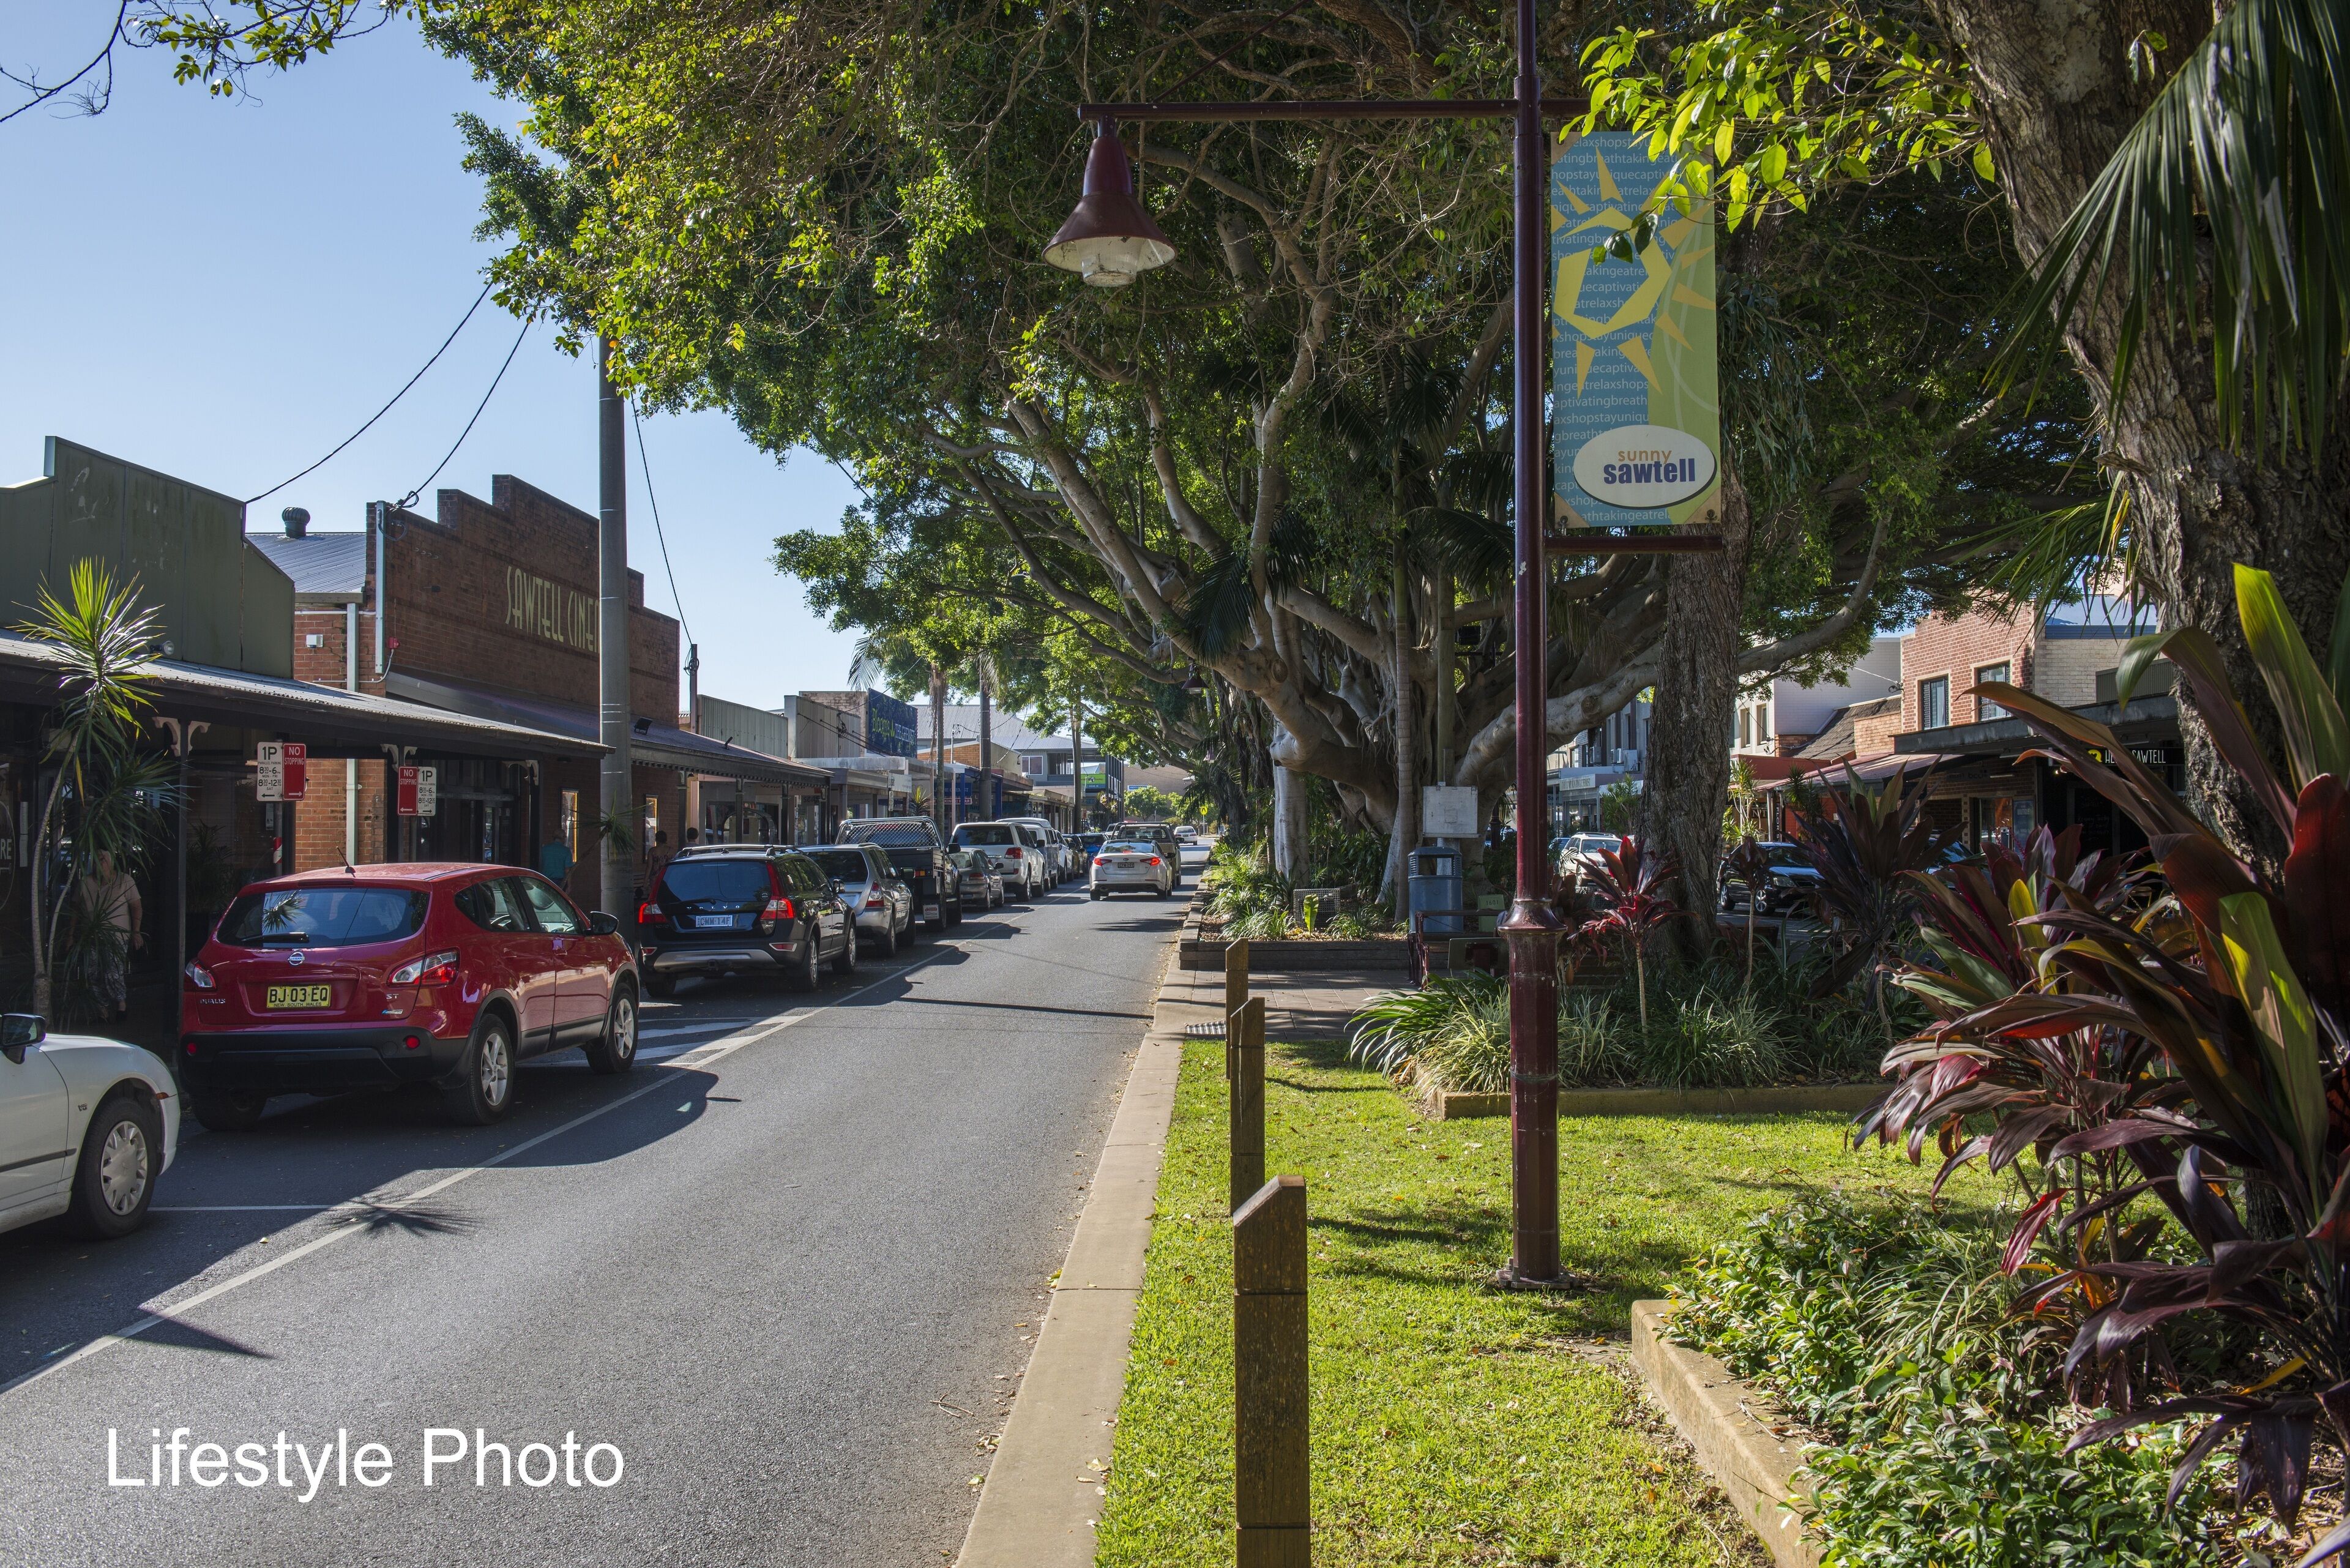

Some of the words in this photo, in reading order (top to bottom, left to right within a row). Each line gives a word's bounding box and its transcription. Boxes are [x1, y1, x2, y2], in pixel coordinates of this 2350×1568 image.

[1618, 450, 1673, 465] sunny
[1603, 458, 1696, 485] sawtell
[505, 566, 564, 643] SAWTELL
[262, 746, 277, 760] 1P
[289, 747, 300, 755] NO
[2132, 749, 2166, 764] SAWTELL
[404, 769, 414, 777] NO
[422, 770, 433, 782] 1P
